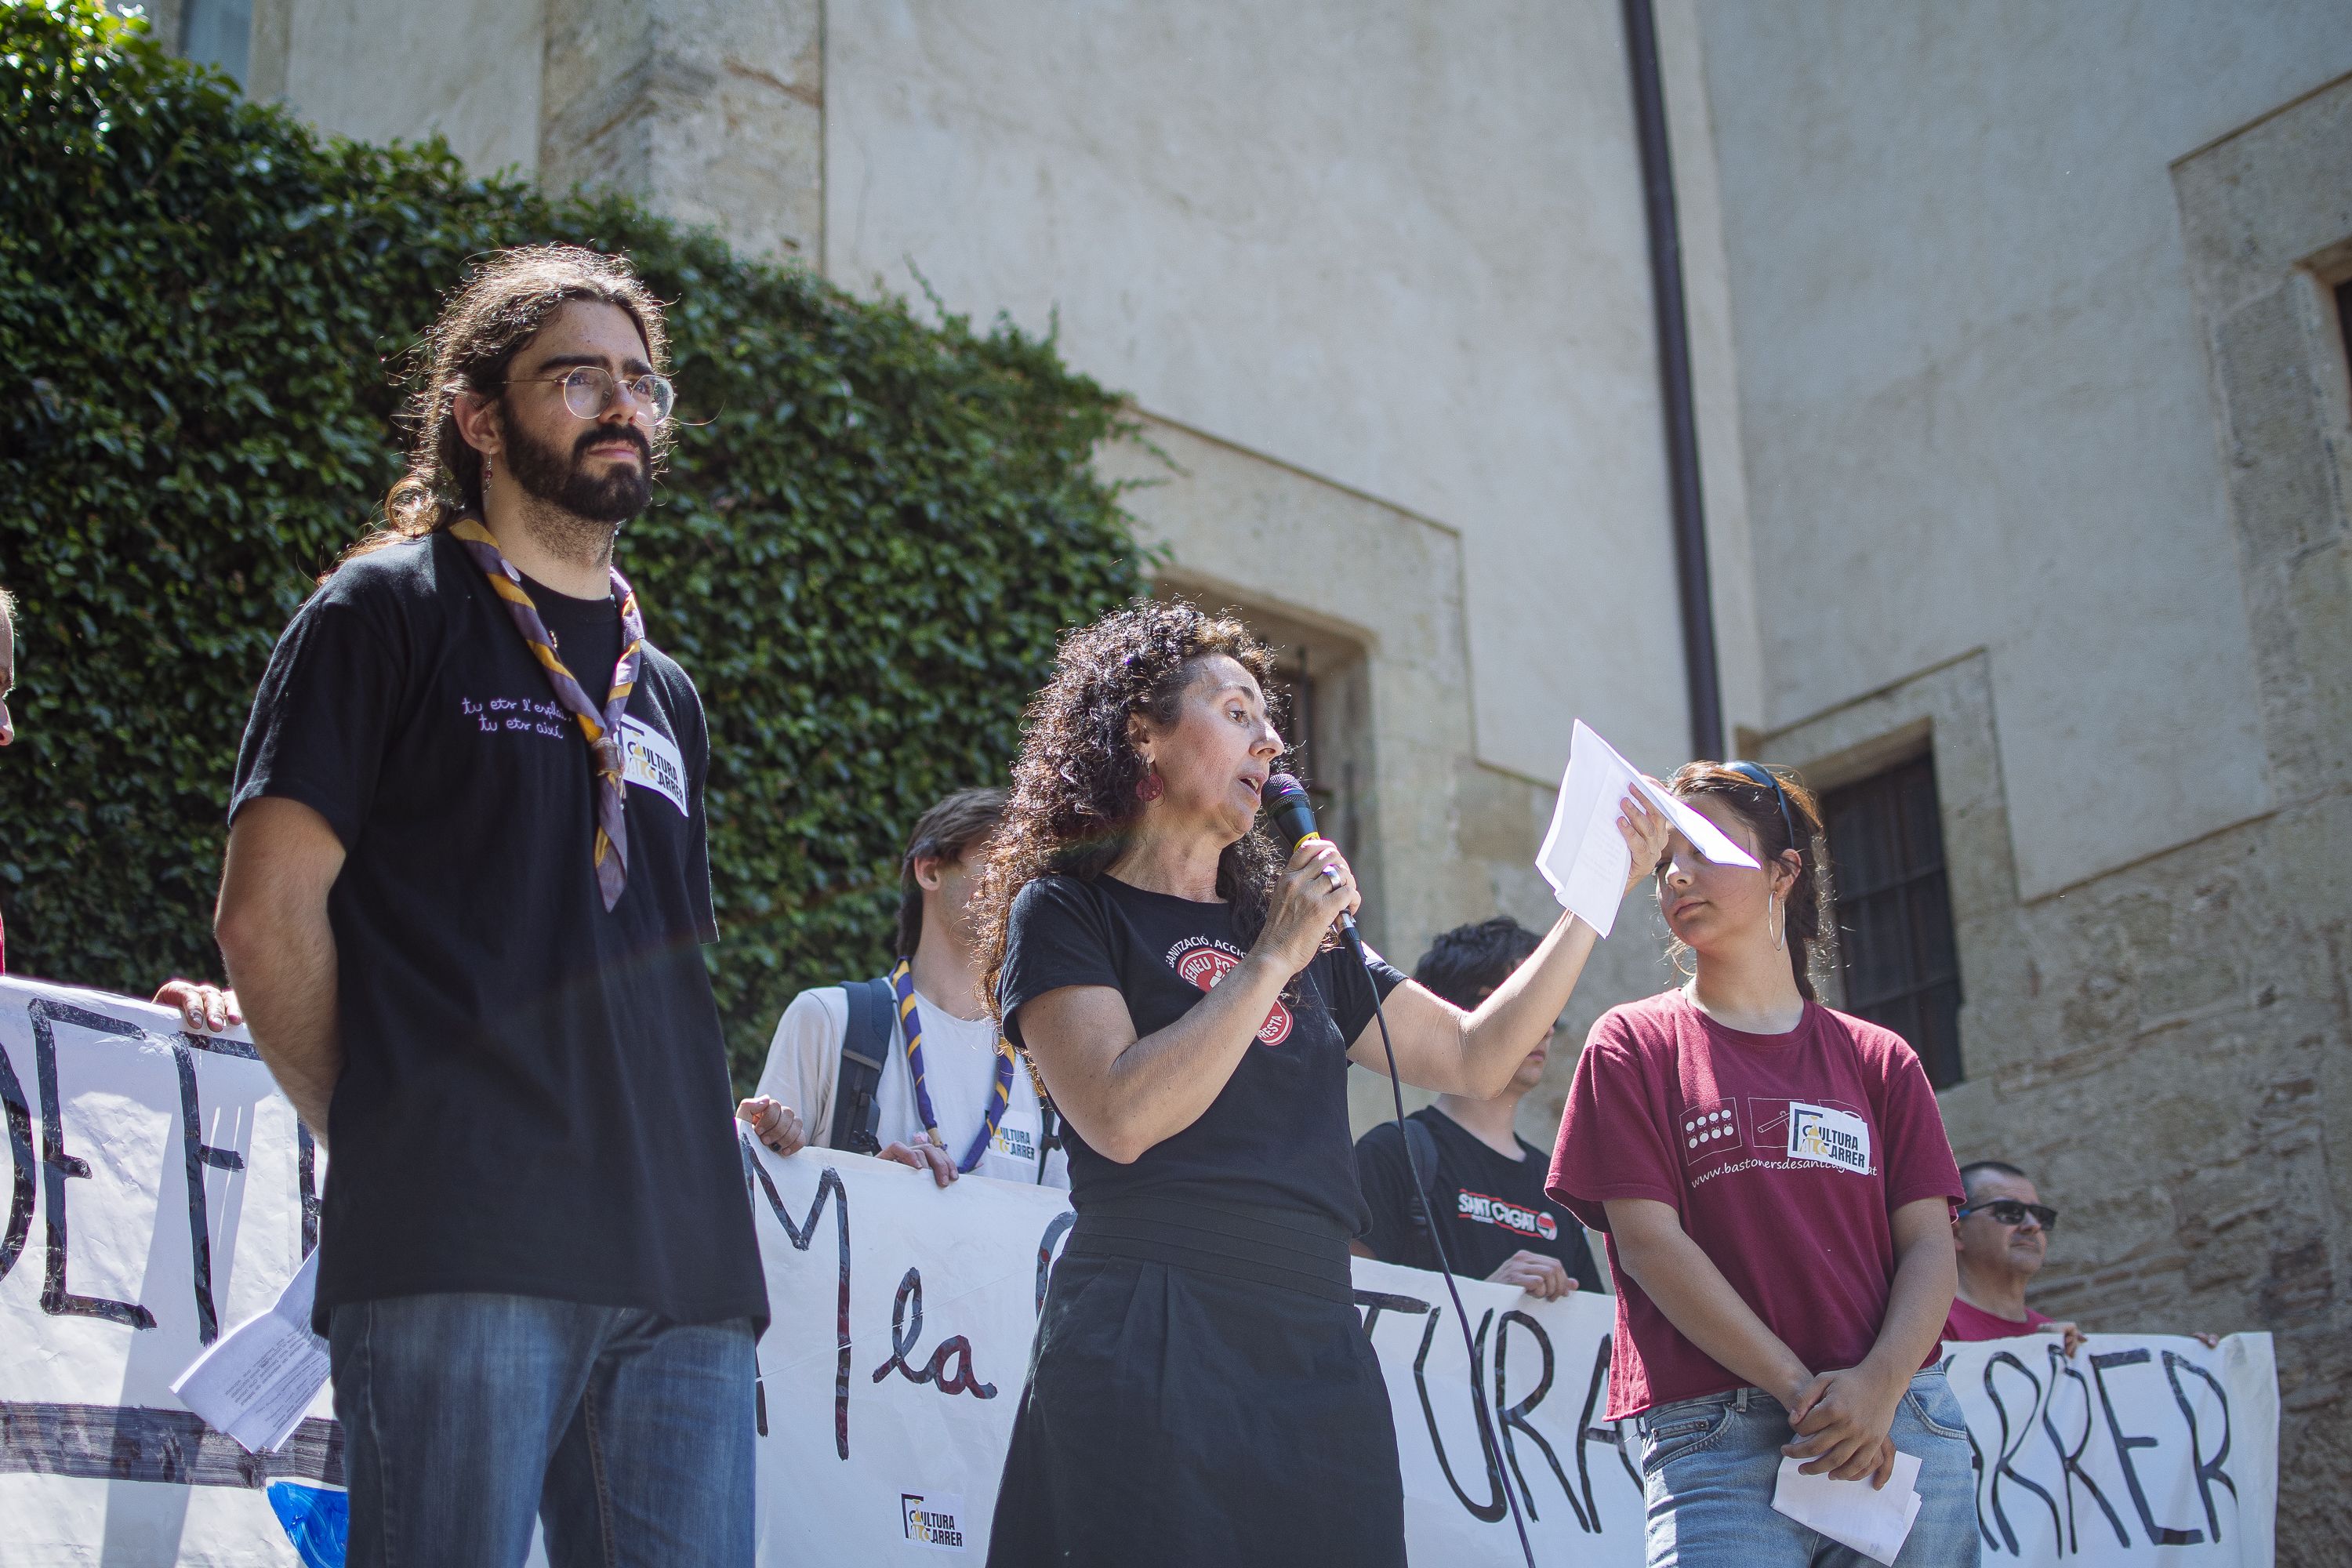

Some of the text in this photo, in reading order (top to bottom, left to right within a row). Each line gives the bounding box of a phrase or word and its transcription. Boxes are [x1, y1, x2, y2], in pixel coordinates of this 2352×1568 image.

[462, 697, 483, 714] tu
[479, 713, 498, 731] tu
[627, 741, 678, 784] CULTURA
[1000, 1127, 1031, 1145] ULTURA
[1802, 1124, 1858, 1151] CULTURA
[873, 1266, 998, 1399] la
[909, 1510, 956, 1530] CULTURA
